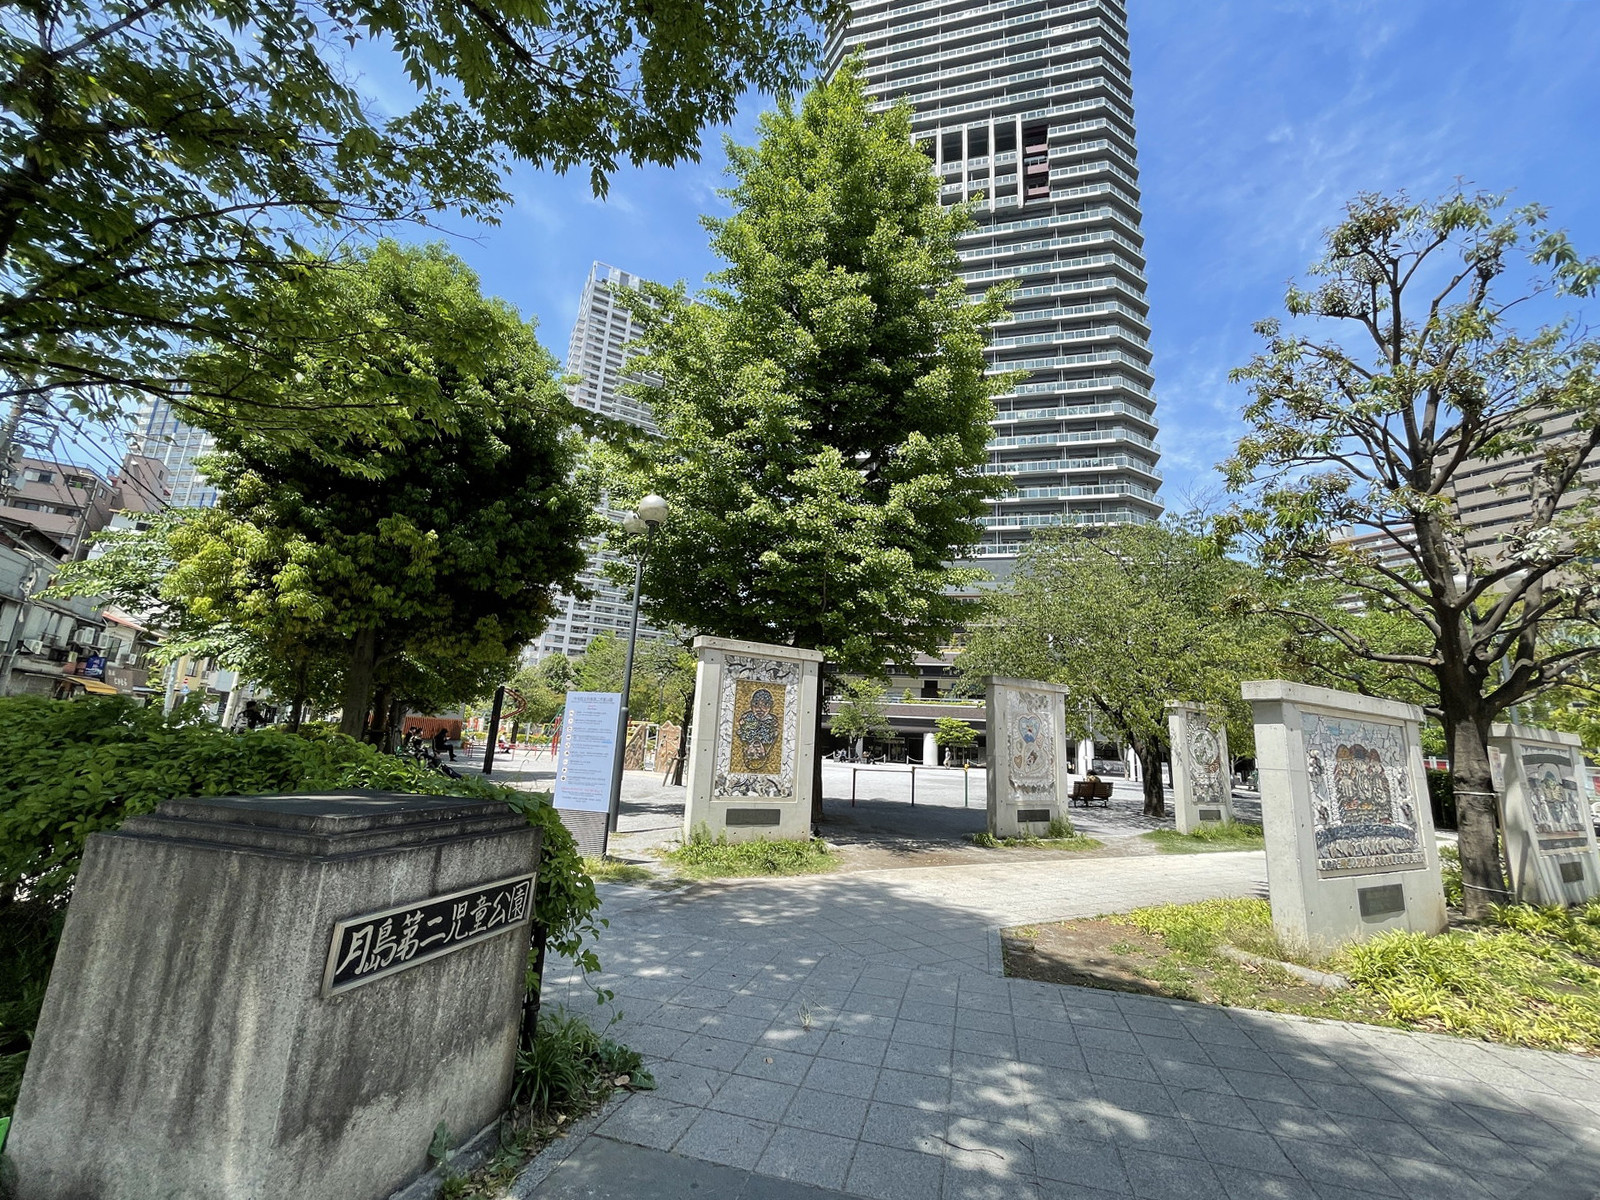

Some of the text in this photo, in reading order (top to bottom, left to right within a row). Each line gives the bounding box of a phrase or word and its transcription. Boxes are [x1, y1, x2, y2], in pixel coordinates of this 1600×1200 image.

[335, 881, 530, 975] 月島第二児童公園
